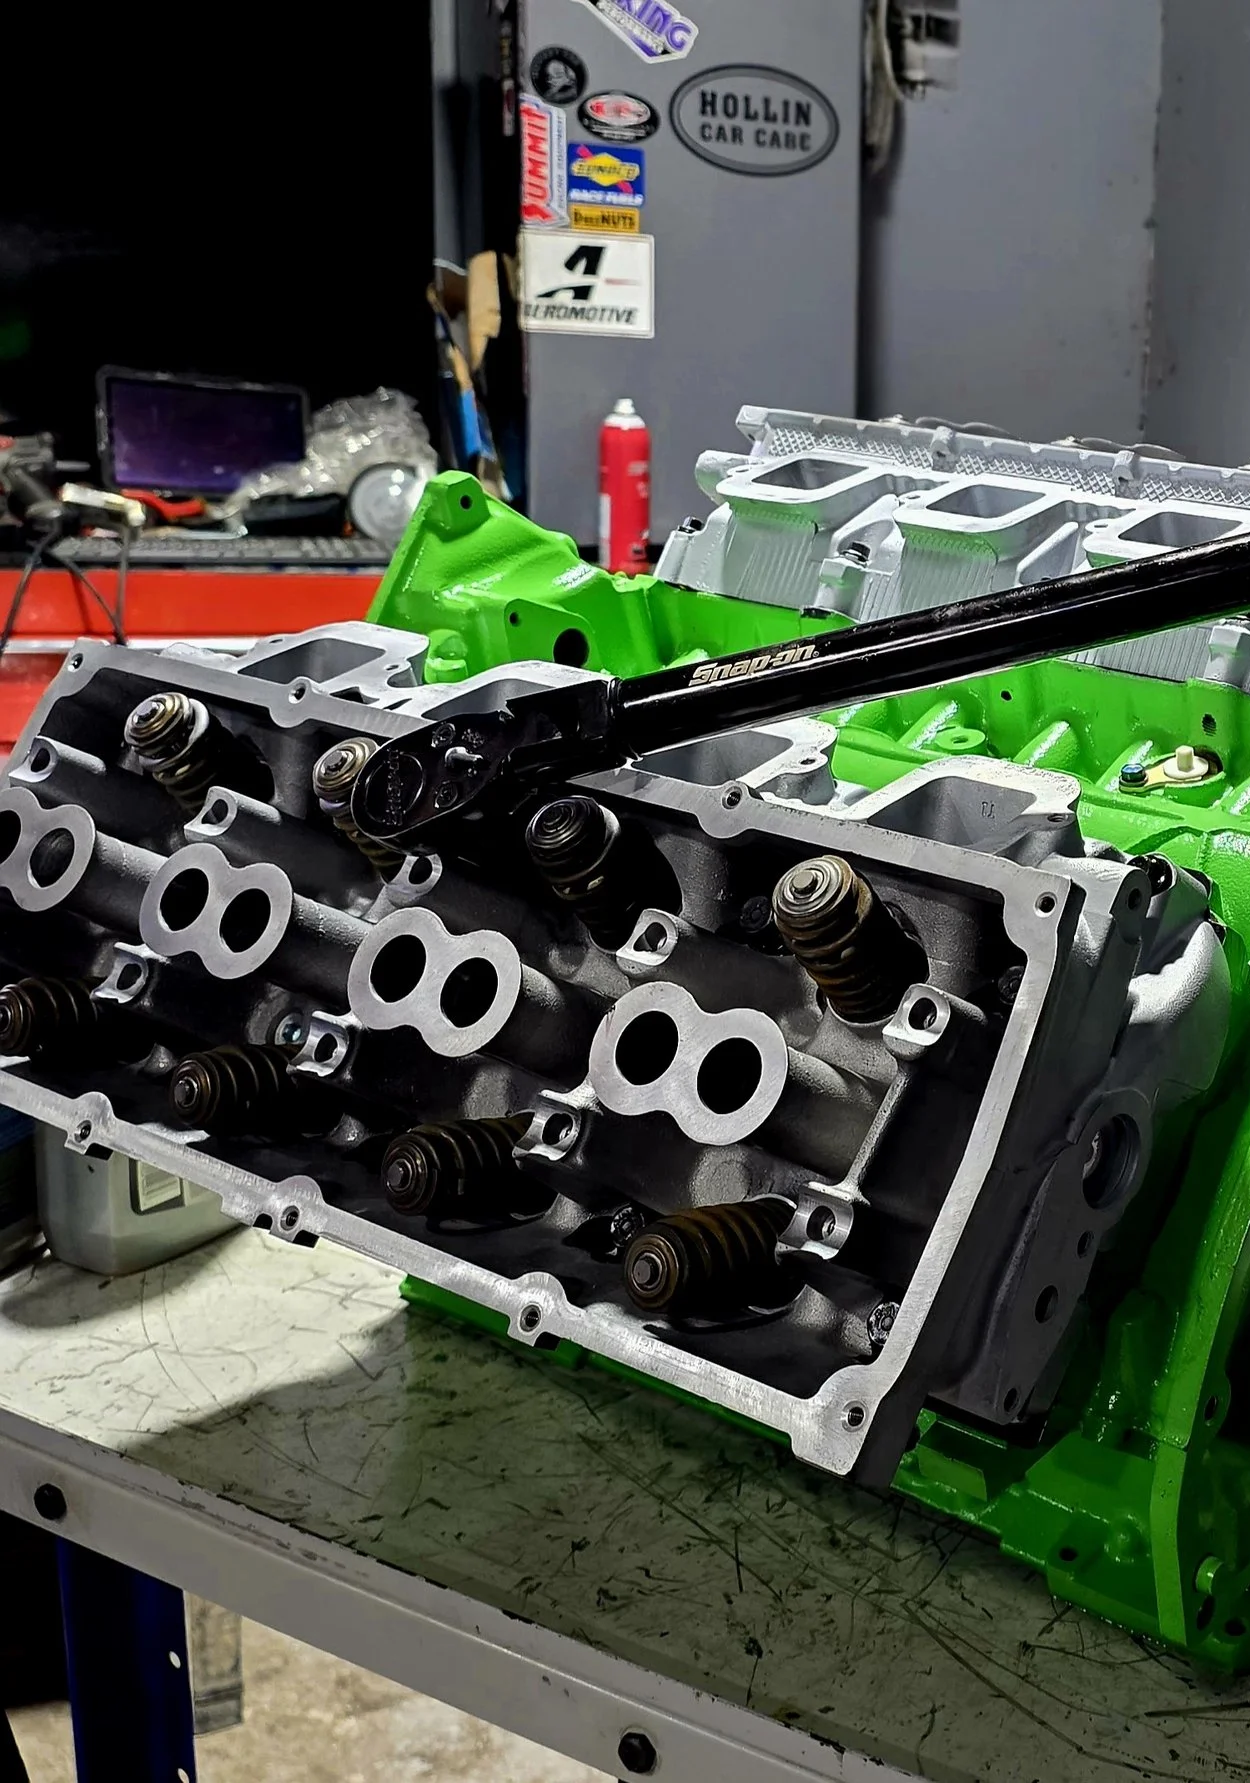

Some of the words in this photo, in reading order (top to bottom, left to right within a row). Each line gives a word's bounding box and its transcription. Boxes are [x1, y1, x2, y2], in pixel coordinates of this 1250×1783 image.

[700, 90, 811, 126] HOLLIN
[700, 123, 743, 145] CAR
[755, 128, 812, 152] CARE
[688, 645, 815, 687] Snap-on
